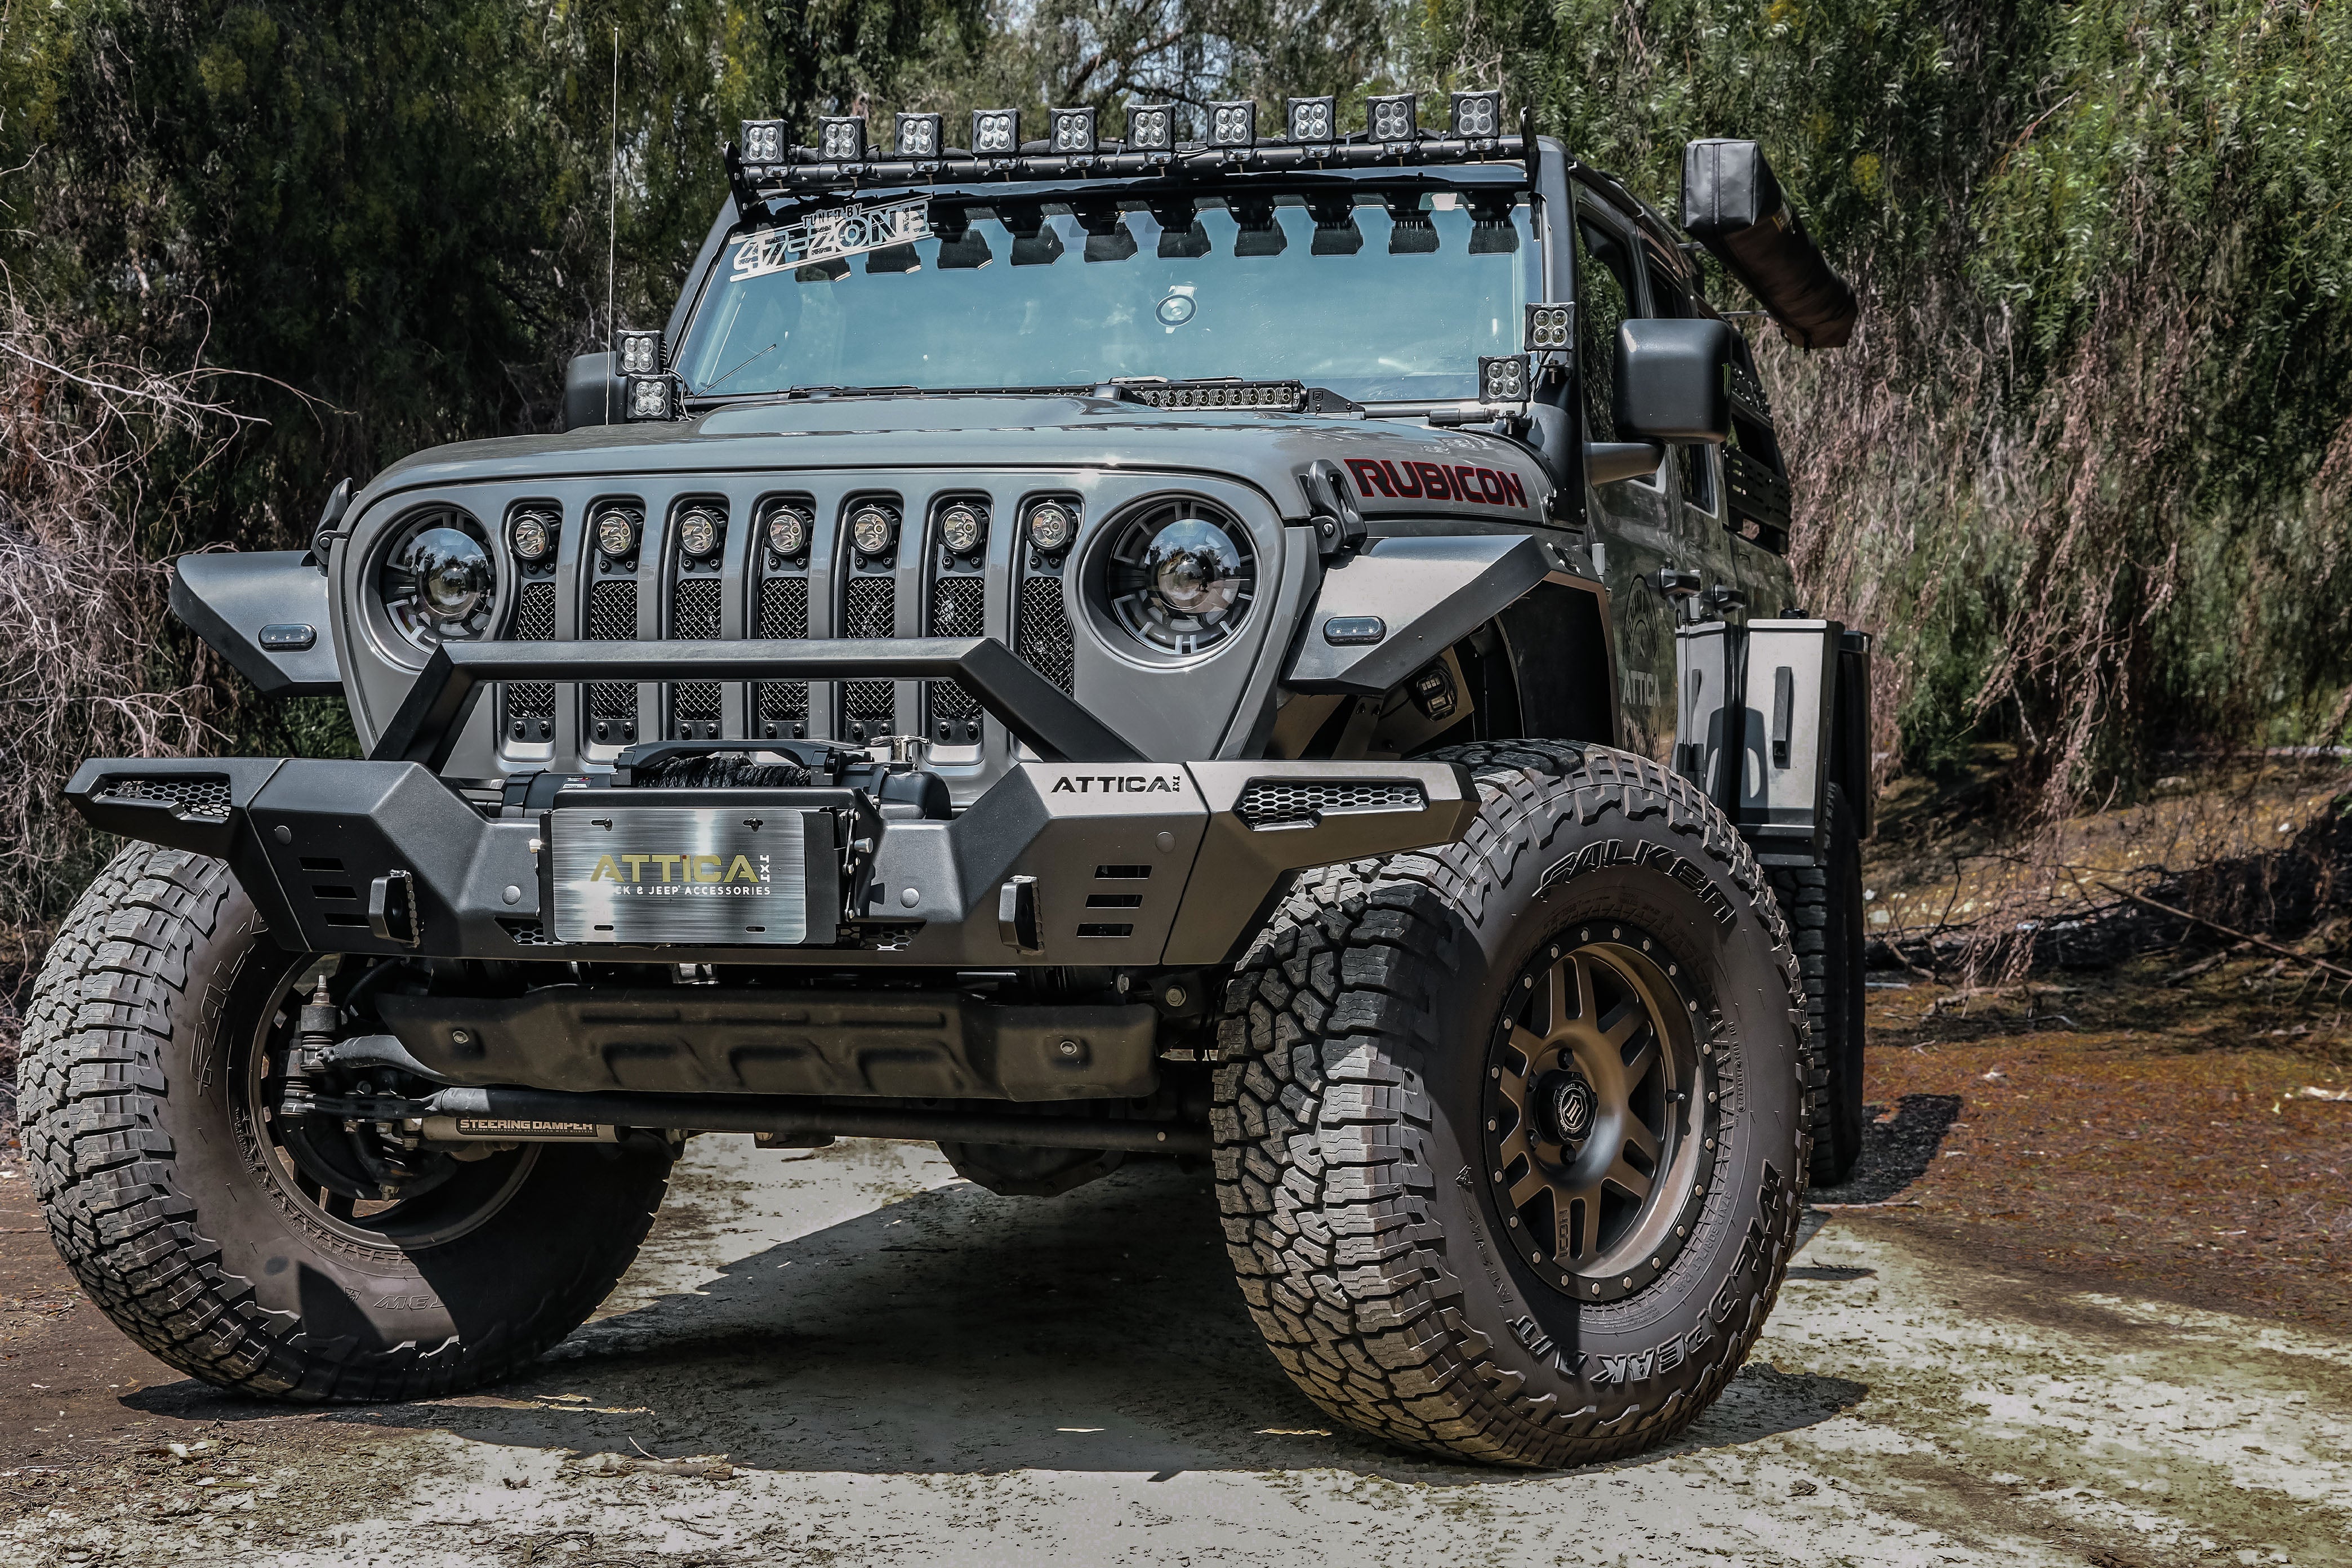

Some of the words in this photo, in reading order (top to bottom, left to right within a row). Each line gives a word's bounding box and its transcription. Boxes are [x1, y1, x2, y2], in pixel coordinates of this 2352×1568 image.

[845, 203, 862, 220] BY
[1343, 458, 1528, 508] RUBICON
[1622, 670, 1661, 707] ATTICA
[1051, 776, 1171, 792] ATTICA
[590, 854, 759, 883] ATTICA
[1532, 839, 1737, 925] FALKEN
[685, 886, 770, 896] ACCESSORIES
[460, 1120, 531, 1129] STEERING
[532, 1121, 593, 1130] DAMPER
[1589, 1159, 1784, 1385] WILDPEAK
